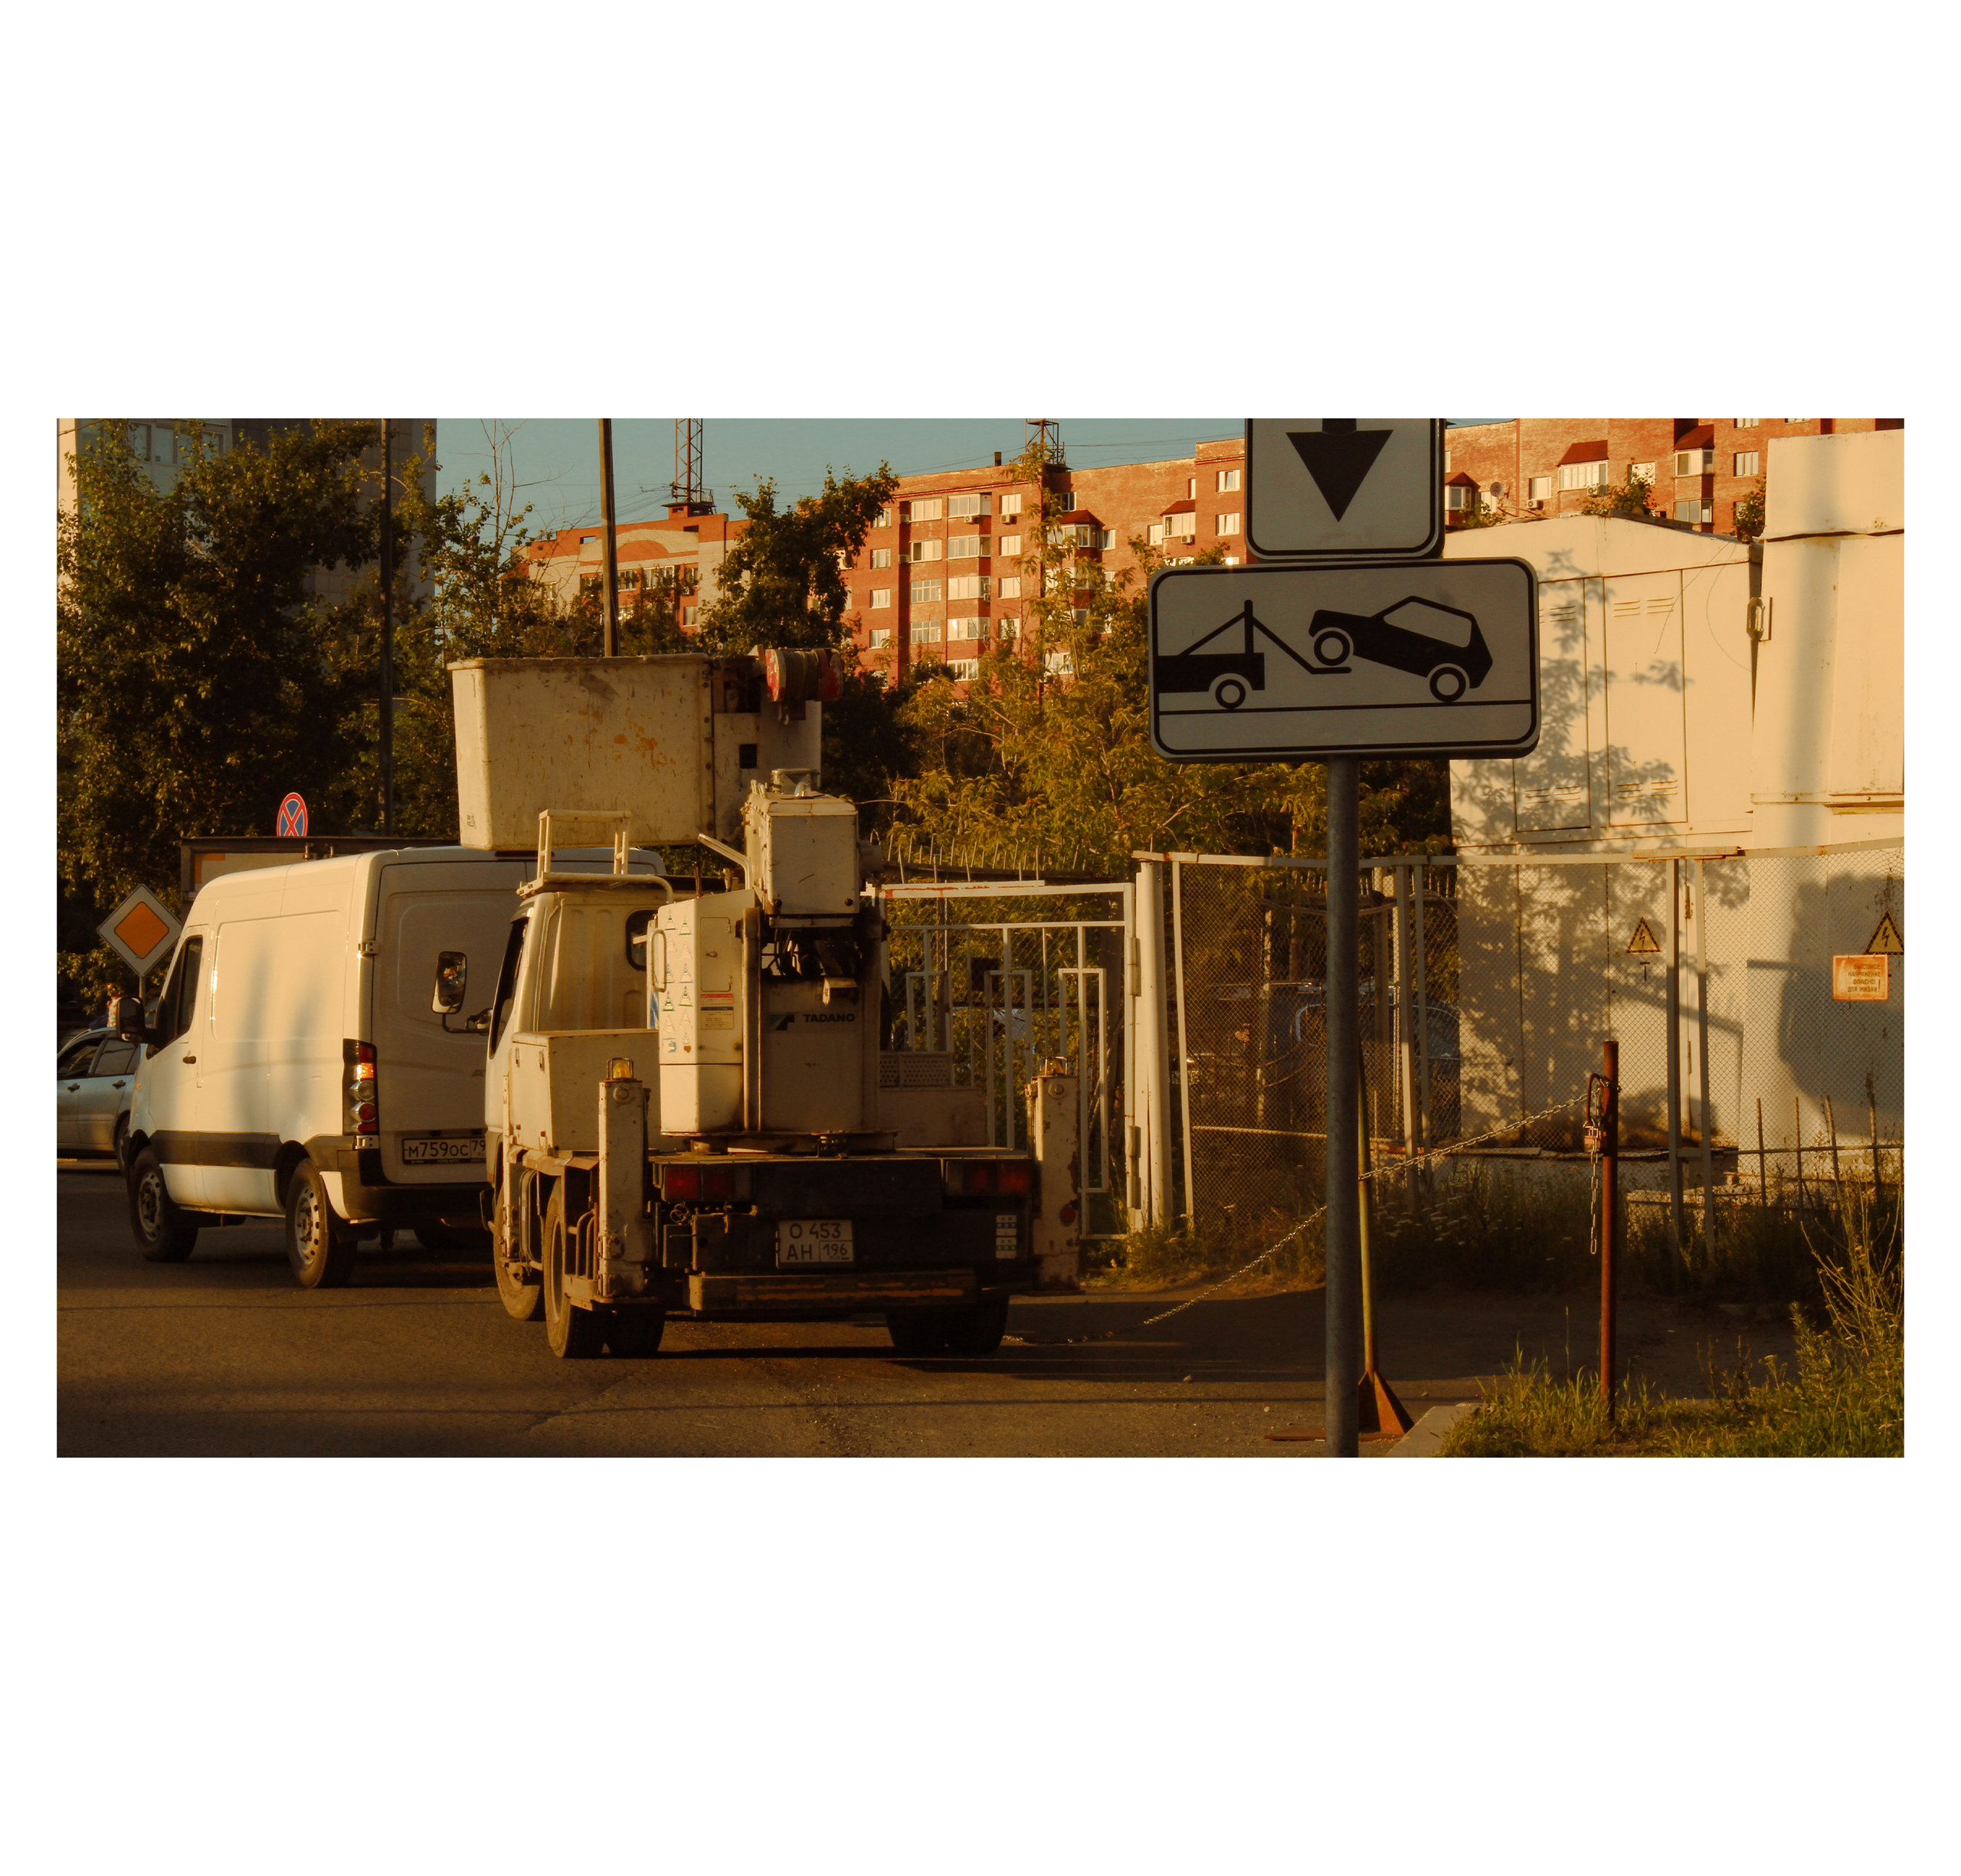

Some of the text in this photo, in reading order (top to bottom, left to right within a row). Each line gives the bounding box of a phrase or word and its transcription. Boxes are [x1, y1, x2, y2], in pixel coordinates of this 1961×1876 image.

[803, 1013, 856, 1023] TADANO
[789, 1223, 841, 1239] О 453
[786, 1242, 848, 1261] АН 196
